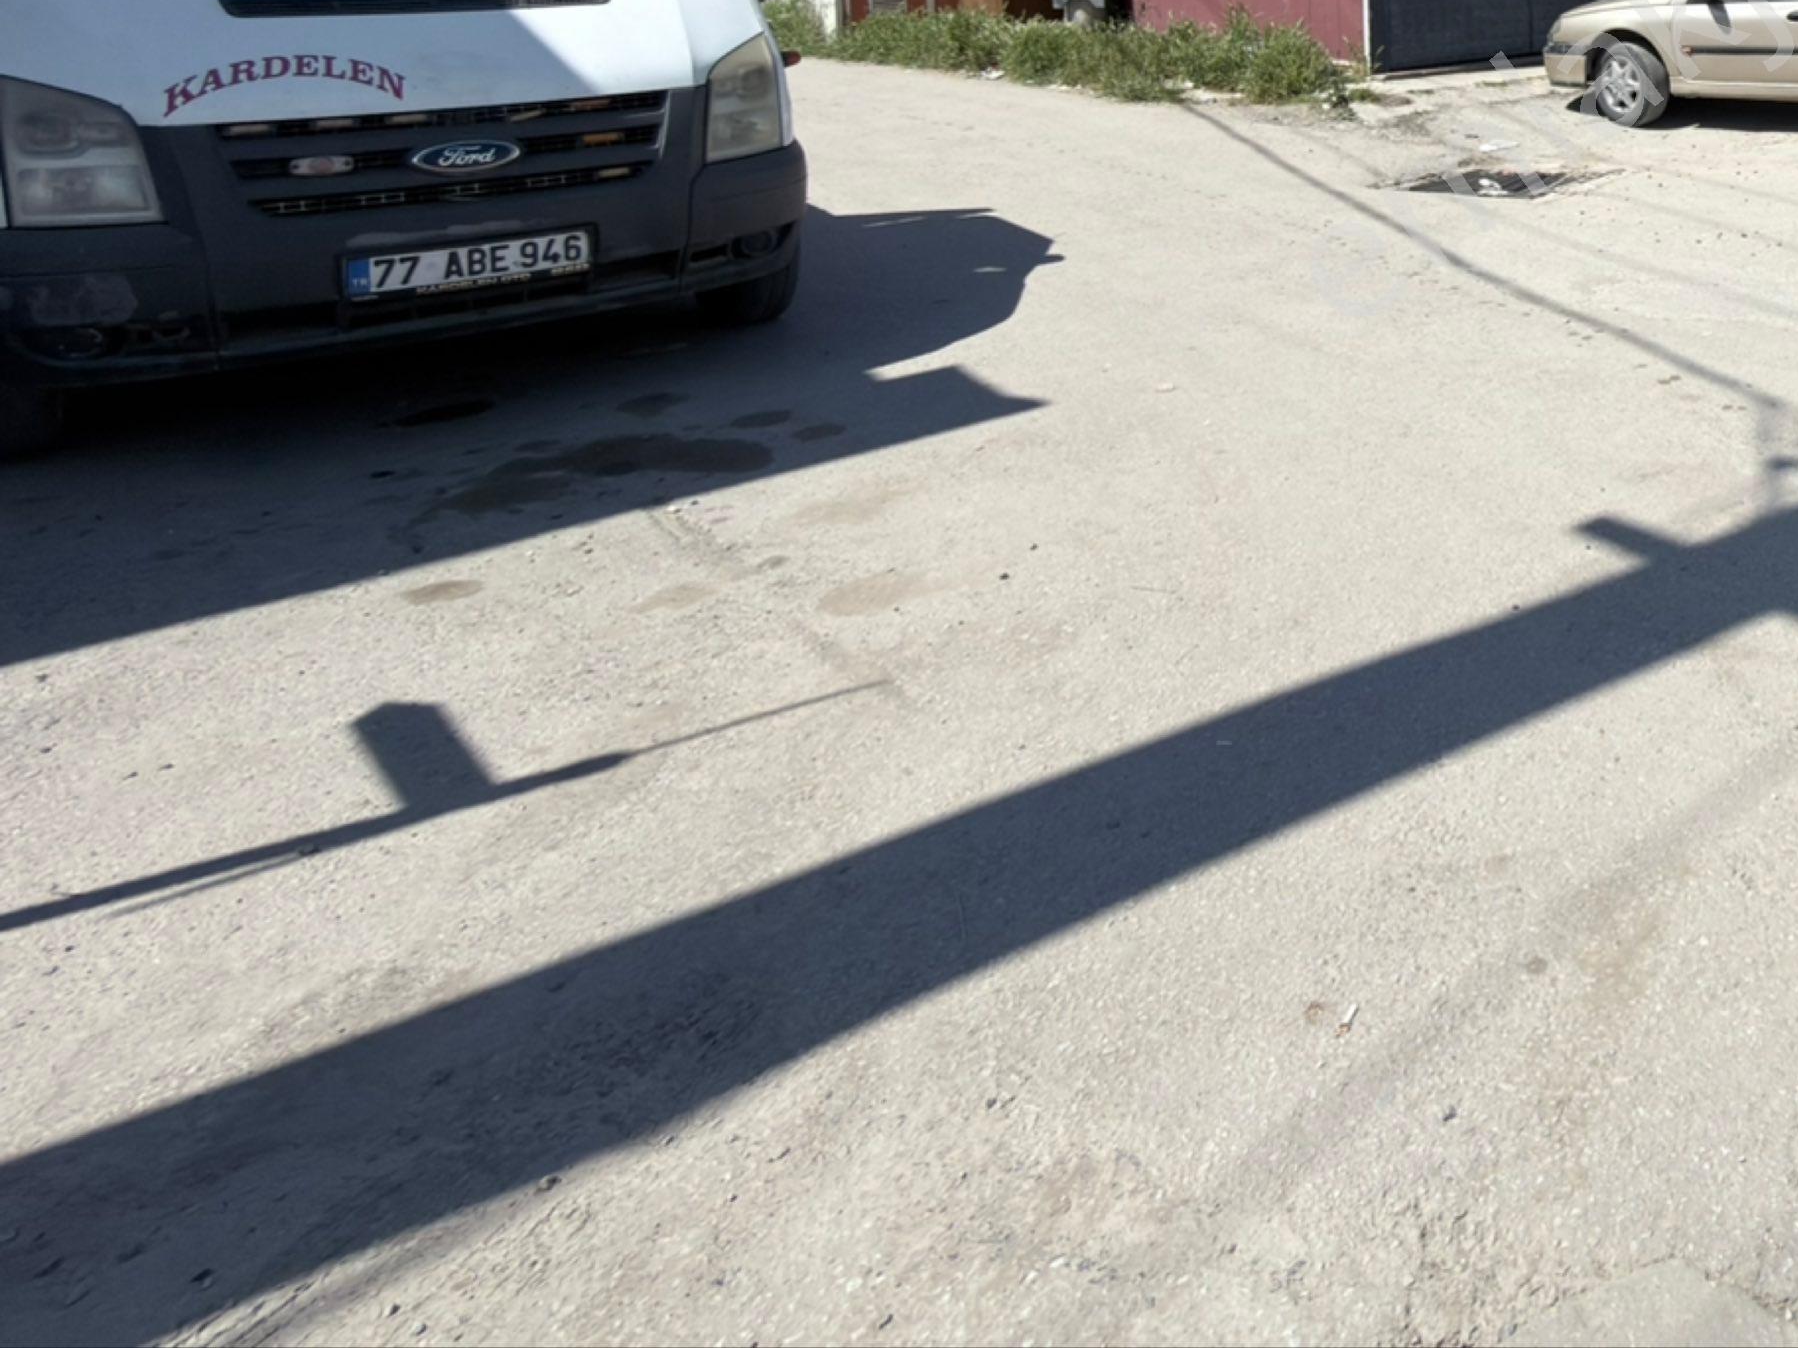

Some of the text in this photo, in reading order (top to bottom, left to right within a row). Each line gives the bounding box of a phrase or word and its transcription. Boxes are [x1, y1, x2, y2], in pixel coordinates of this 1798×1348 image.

[164, 54, 405, 118] KARDELEN
[438, 145, 496, 167] Ford
[374, 256, 421, 289] 77
[444, 244, 510, 280] ABE
[519, 234, 582, 269] 946
